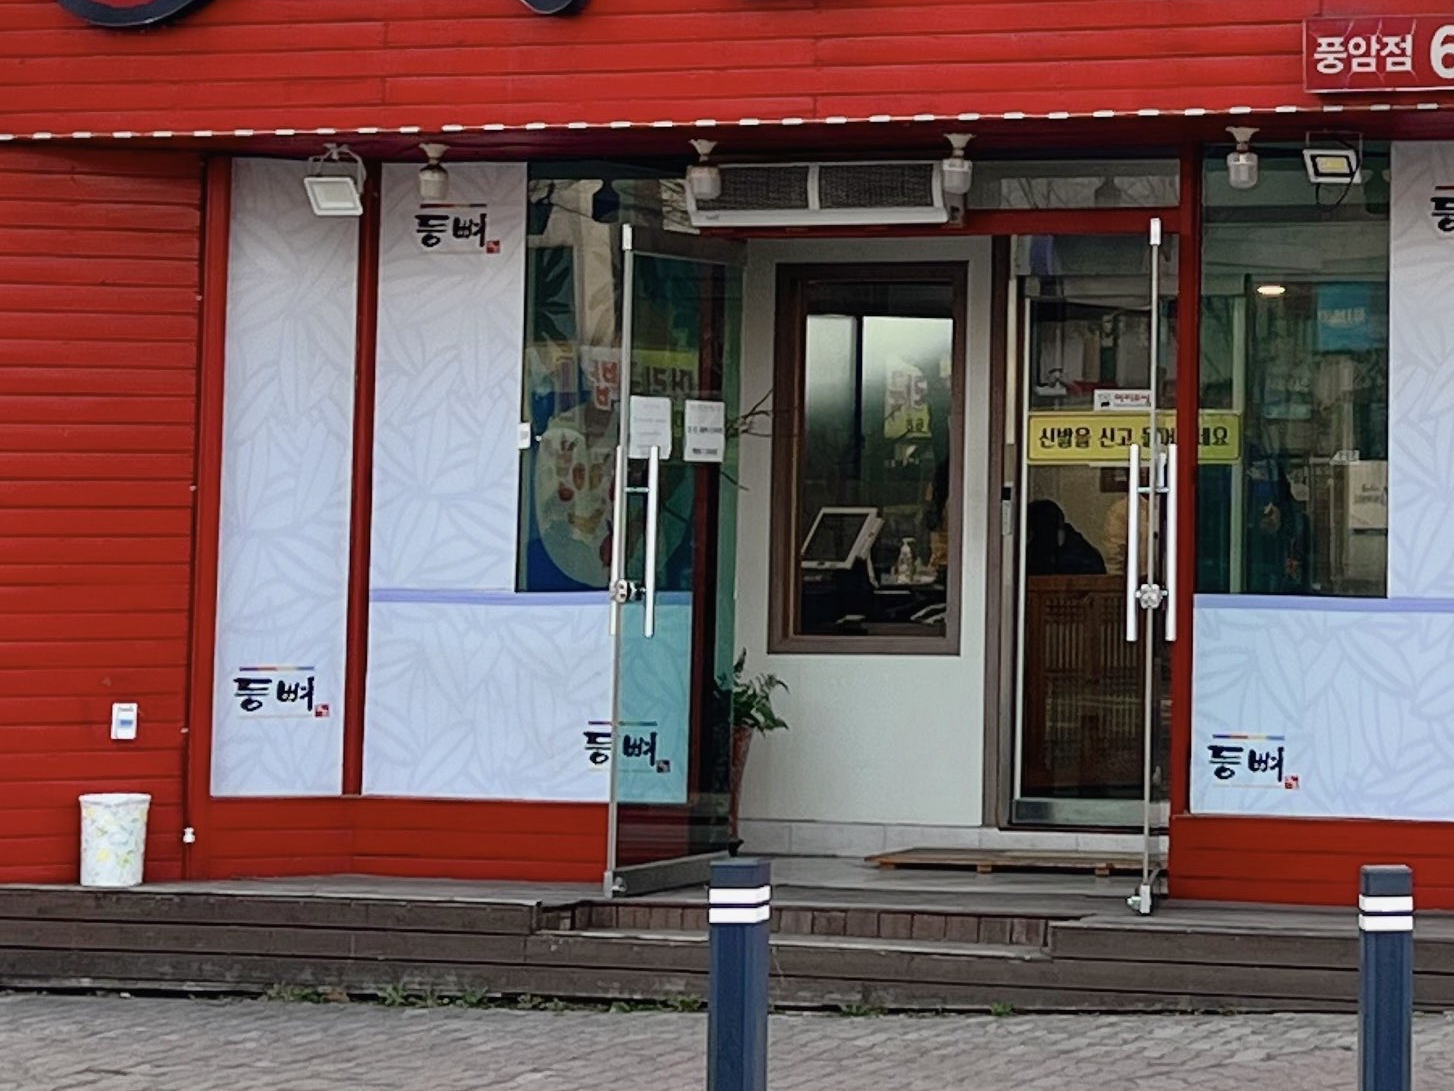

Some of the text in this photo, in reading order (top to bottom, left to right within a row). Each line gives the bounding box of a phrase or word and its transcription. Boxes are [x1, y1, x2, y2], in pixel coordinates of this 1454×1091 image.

[1313, 32, 1415, 75] 풍암점
[414, 212, 488, 248] 등뼈
[1039, 426, 1091, 449] 신발을
[1100, 426, 1133, 448] 신고
[233, 677, 315, 711] 등뼈
[1207, 744, 1285, 782] 등뼈
